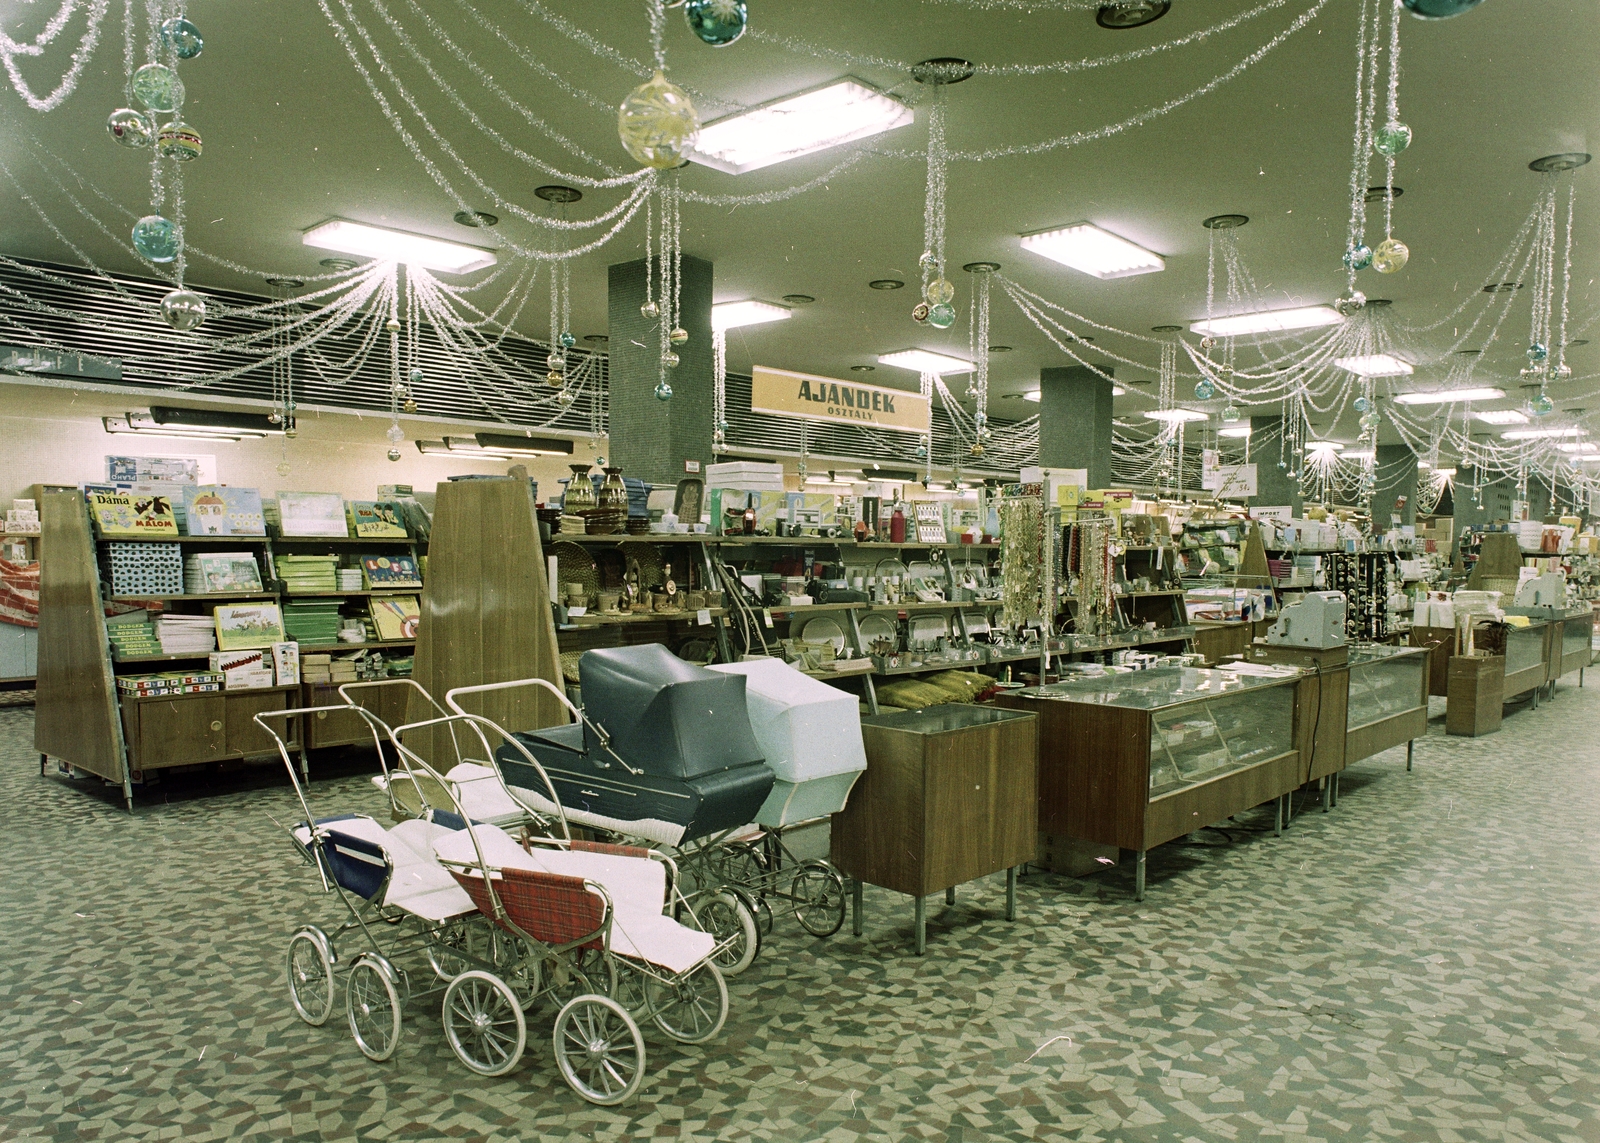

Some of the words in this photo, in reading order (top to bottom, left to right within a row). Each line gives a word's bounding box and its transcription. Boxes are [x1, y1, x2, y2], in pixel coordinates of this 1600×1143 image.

[798, 380, 895, 413] AJÁNDÉK
[828, 406, 873, 420] OSZTÁLY
[97, 495, 130, 505] Dáma
